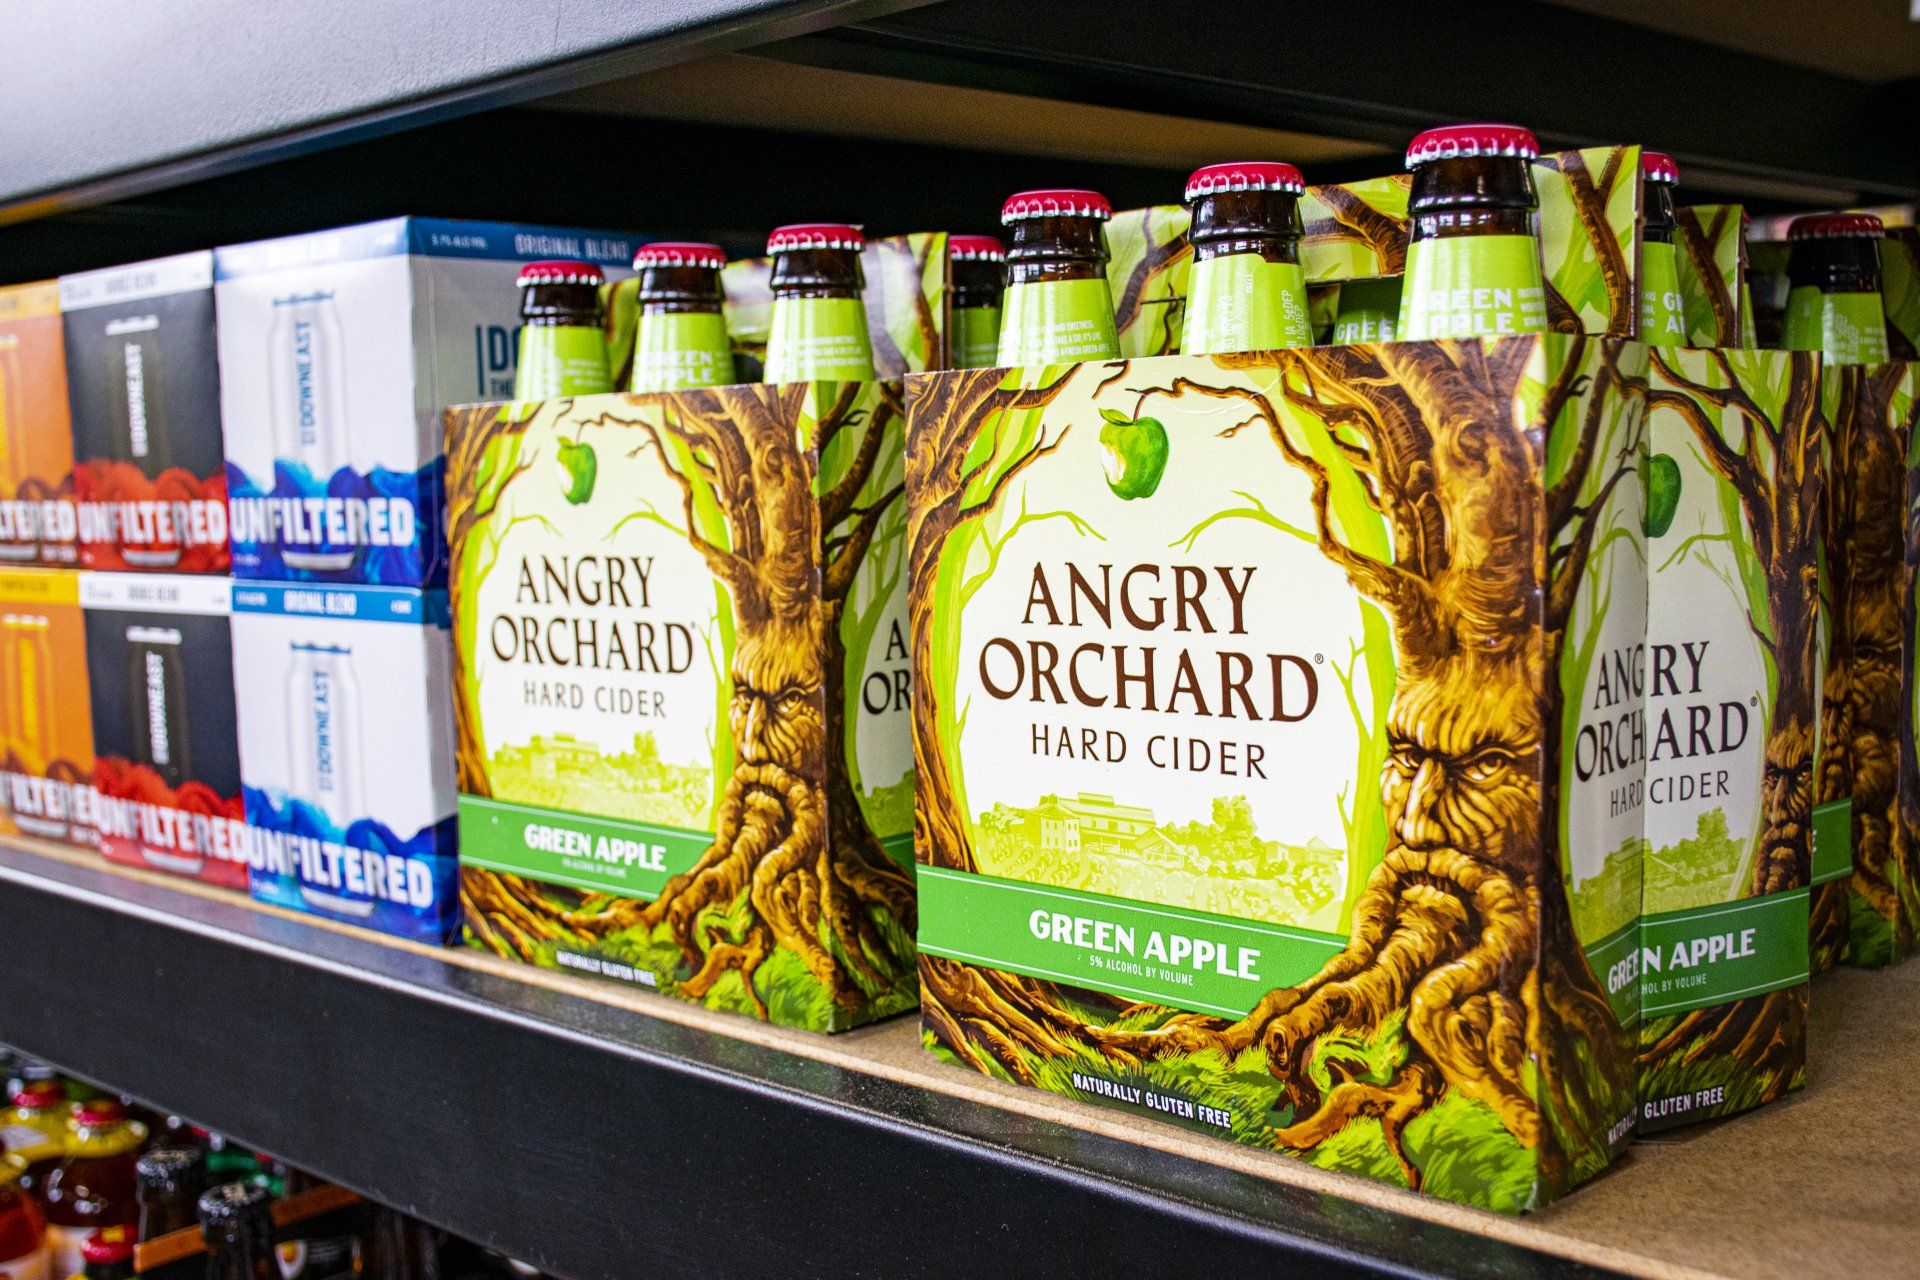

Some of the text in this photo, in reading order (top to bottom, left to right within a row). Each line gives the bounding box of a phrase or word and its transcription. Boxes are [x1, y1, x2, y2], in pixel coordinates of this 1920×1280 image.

[514, 233, 580, 258] ORIGINAL
[584, 238, 630, 260] BLEND
[1412, 287, 1513, 310] REEN
[1411, 312, 1516, 338] PPLE
[295, 321, 315, 427] DOWNEAST
[78, 500, 229, 545] UNFILTERED
[230, 497, 415, 546] UNFILTERED
[517, 554, 655, 607] ANGRY
[1021, 562, 1257, 635] ANGRY
[313, 670, 332, 774] DOWNEAST
[524, 681, 667, 718] HARD CIDER
[1031, 723, 1268, 779] HARD CIDER
[1610, 770, 1730, 818] HARD CIDER
[100, 793, 249, 864] UNFILTERED
[524, 823, 667, 872] GREEN APPLE
[250, 824, 434, 909] UNFILTERED
[1029, 909, 1260, 981] GREEN APPLE
[1608, 928, 1755, 995] GREEN APPLE
[1090, 955, 1194, 986] 5% ALCOHOL BY VOLUME
[1662, 979, 1672, 992] BY
[1676, 973, 1707, 989] VOLUME
[1073, 1073, 1232, 1128] NATURALLY GLUTEN FREE
[1644, 1094, 1692, 1119] GLUTEN
[1695, 1086, 1724, 1109] FREE
